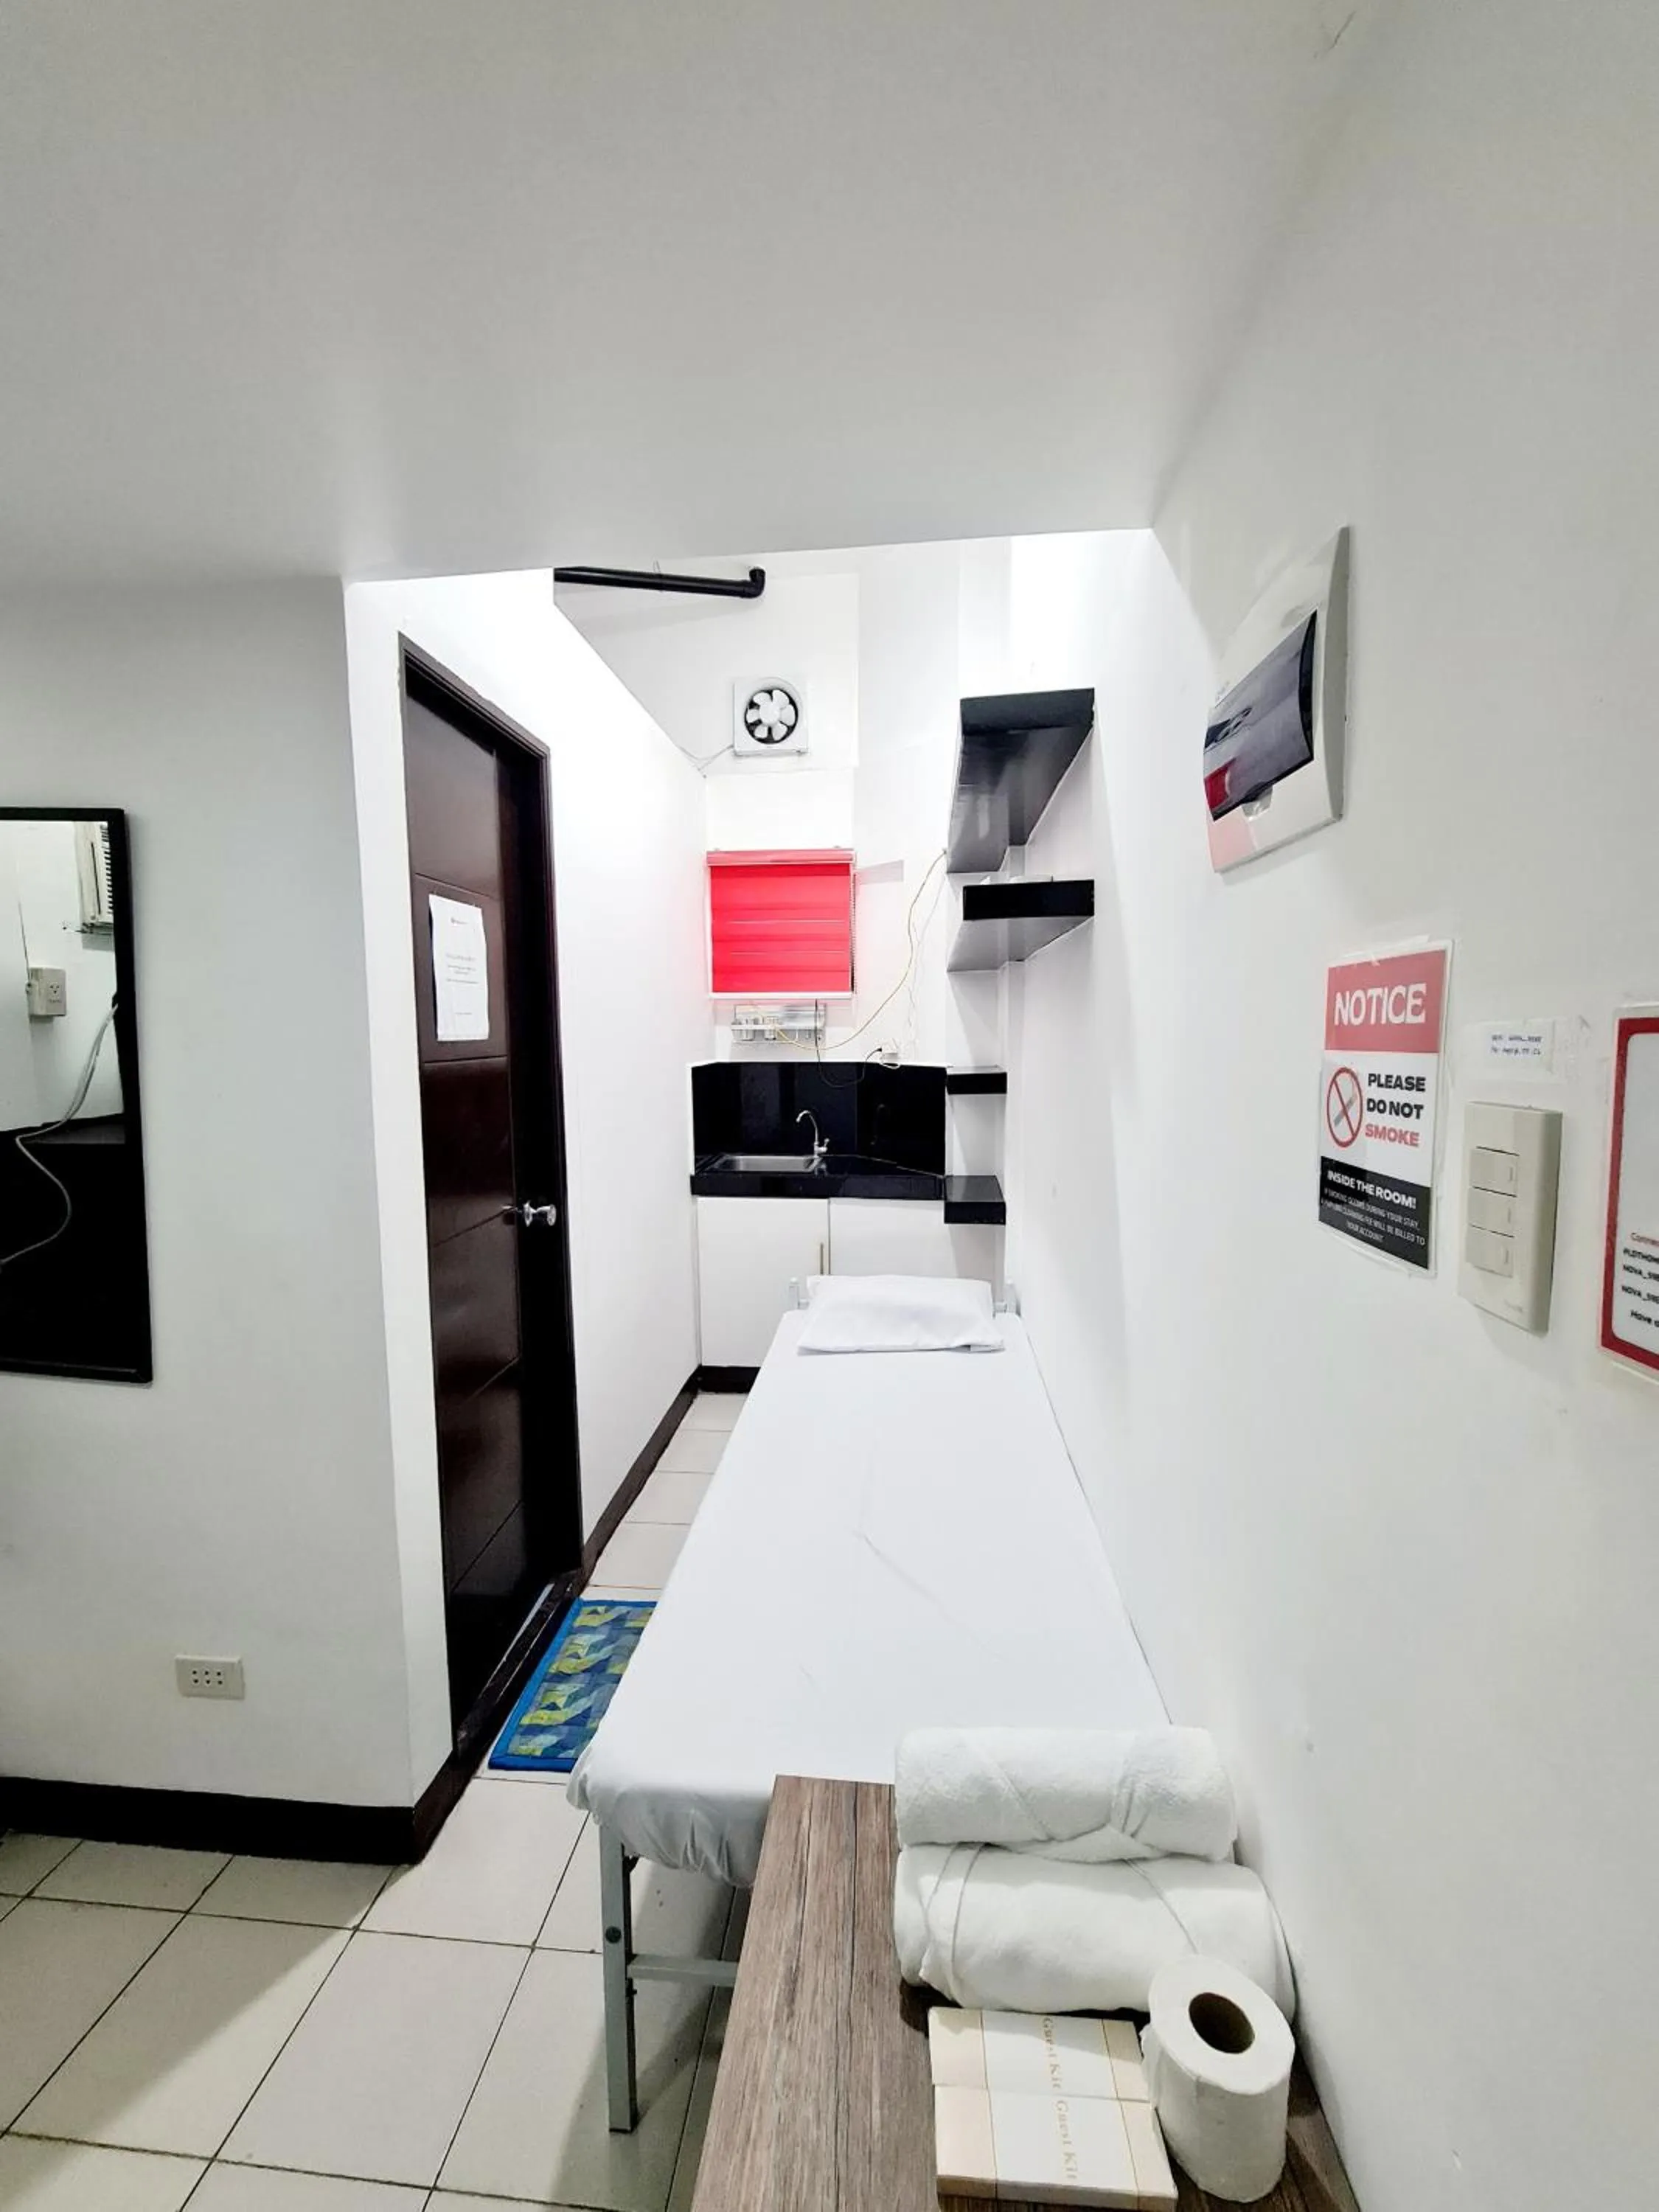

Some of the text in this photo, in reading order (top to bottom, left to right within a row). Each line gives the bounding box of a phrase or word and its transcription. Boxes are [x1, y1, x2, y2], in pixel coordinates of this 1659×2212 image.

[1334, 983, 1427, 1026] NOTICE
[1368, 1074, 1426, 1092] PLEASE
[1366, 1098, 1424, 1119] DO NOT
[1365, 1123, 1420, 1147] SMOKE
[1328, 1169, 1416, 1209] INSIDE THE ROOM!
[1394, 1228, 1415, 1242] BILLED
[1416, 1235, 1425, 1245] TO
[1056, 2099, 1073, 2145] Guest
